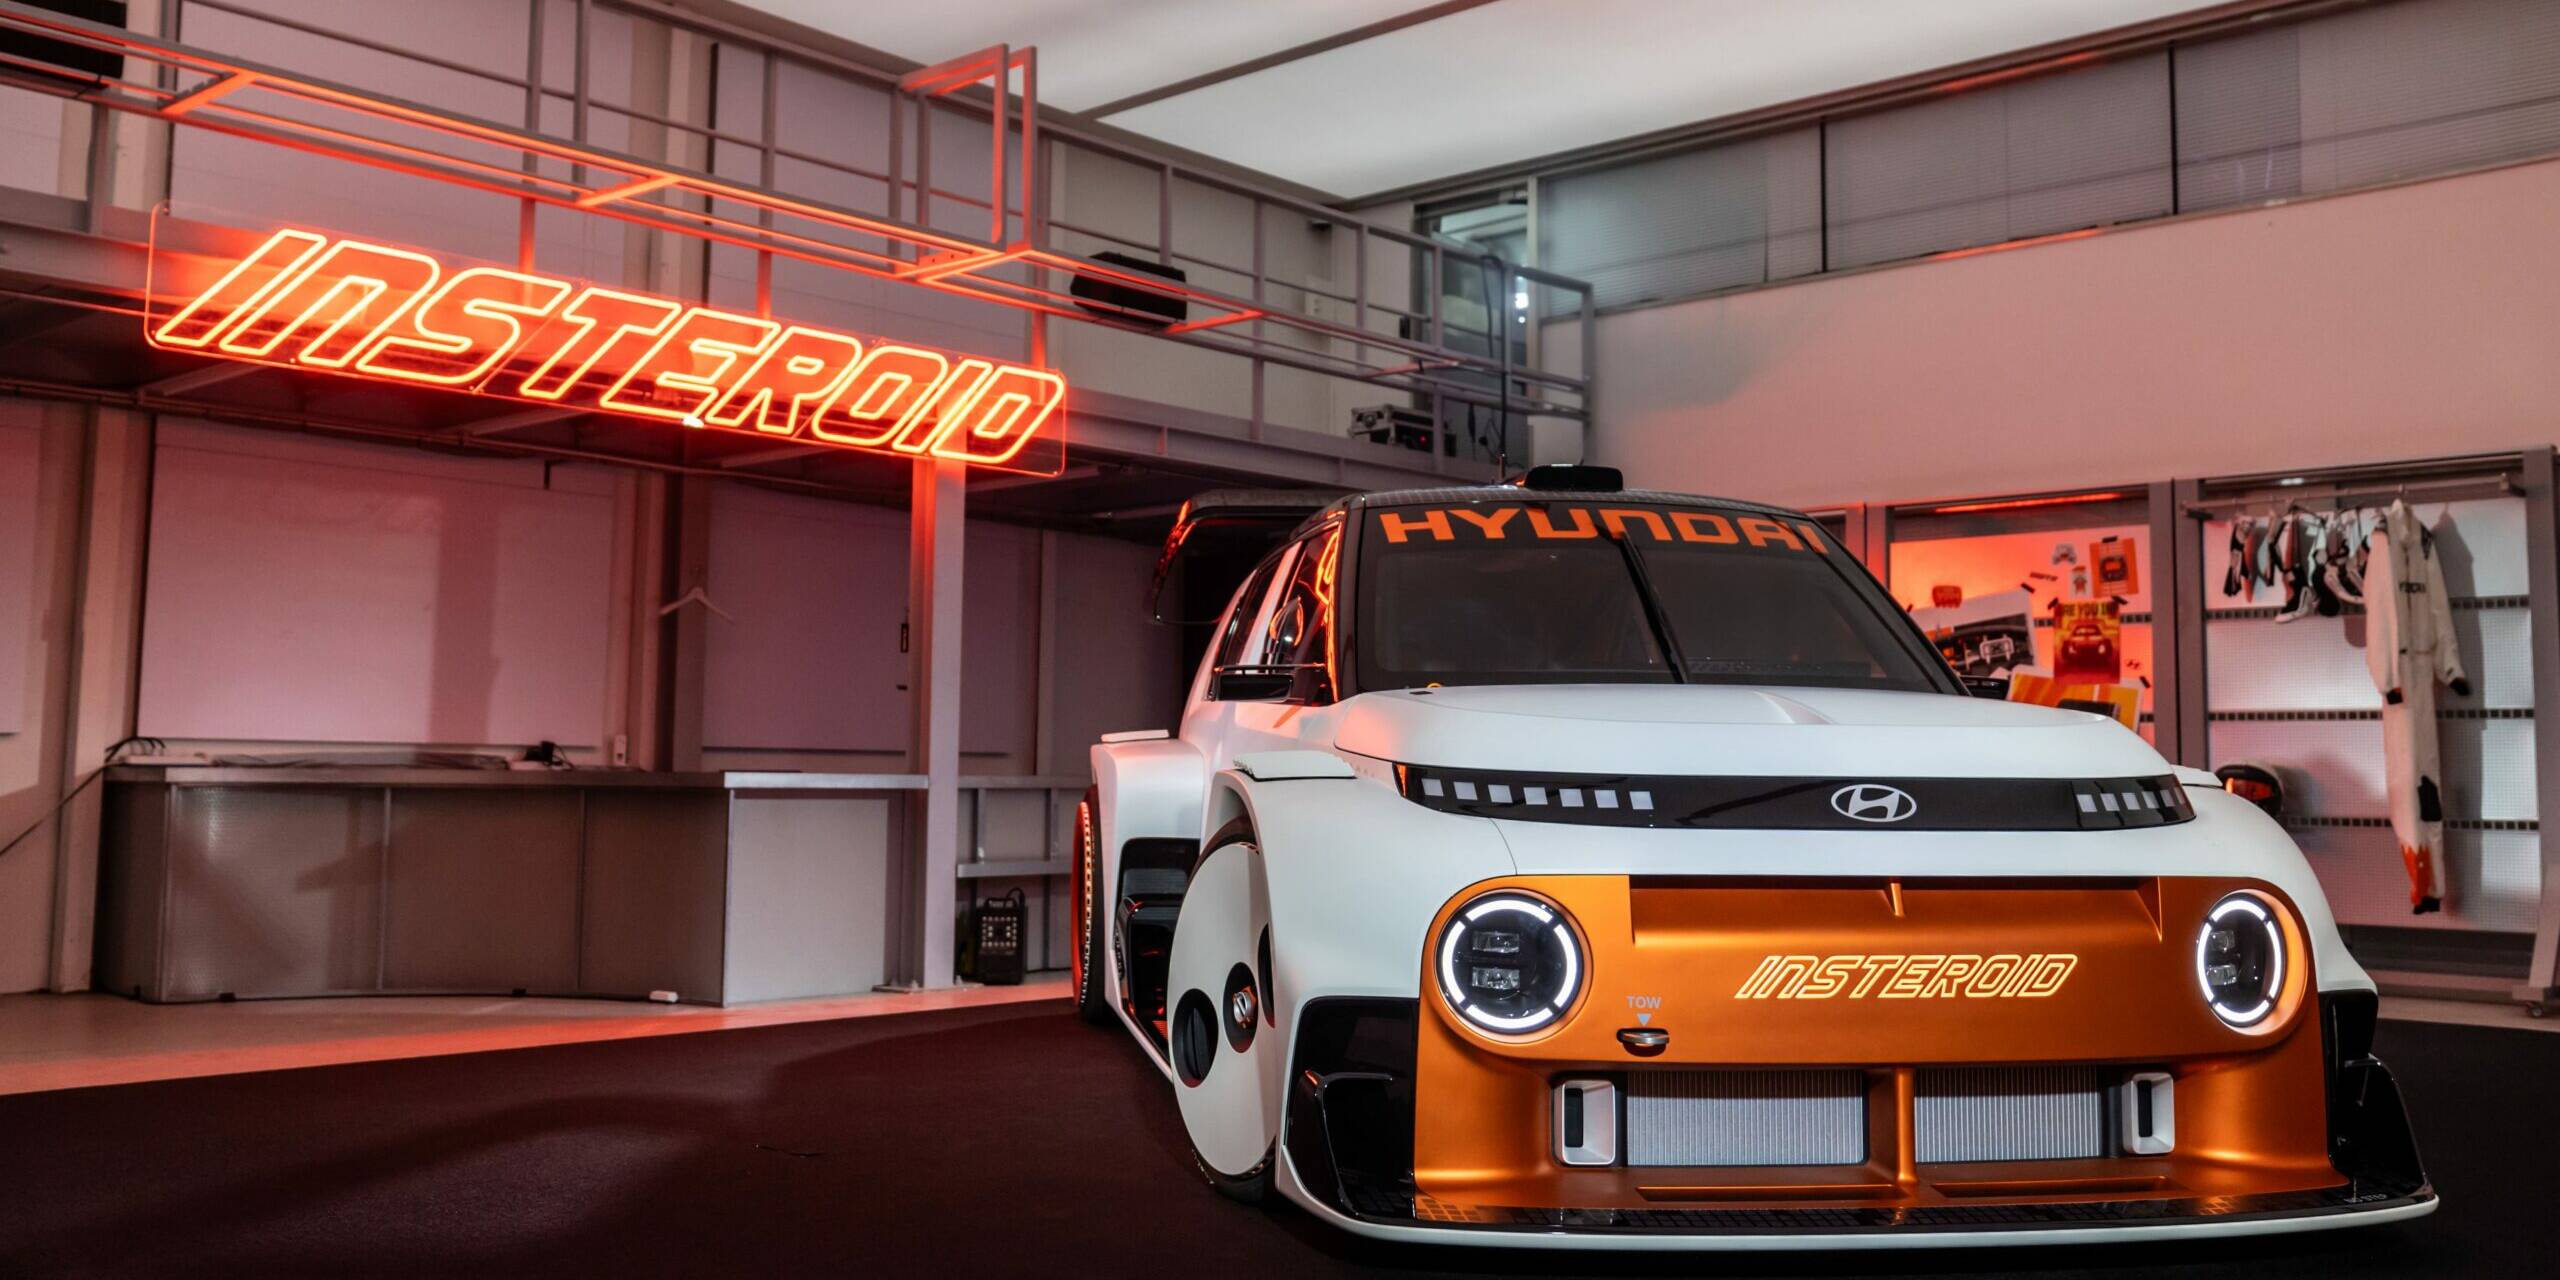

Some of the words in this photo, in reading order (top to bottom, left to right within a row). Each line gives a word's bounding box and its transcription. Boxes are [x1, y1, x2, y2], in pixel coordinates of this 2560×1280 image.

[156, 228, 1066, 463] INSTEROID
[1379, 508, 1829, 554] HYUNDAI
[1734, 954, 2078, 999] INSTEROID
[1625, 995, 1662, 1009] TOW
